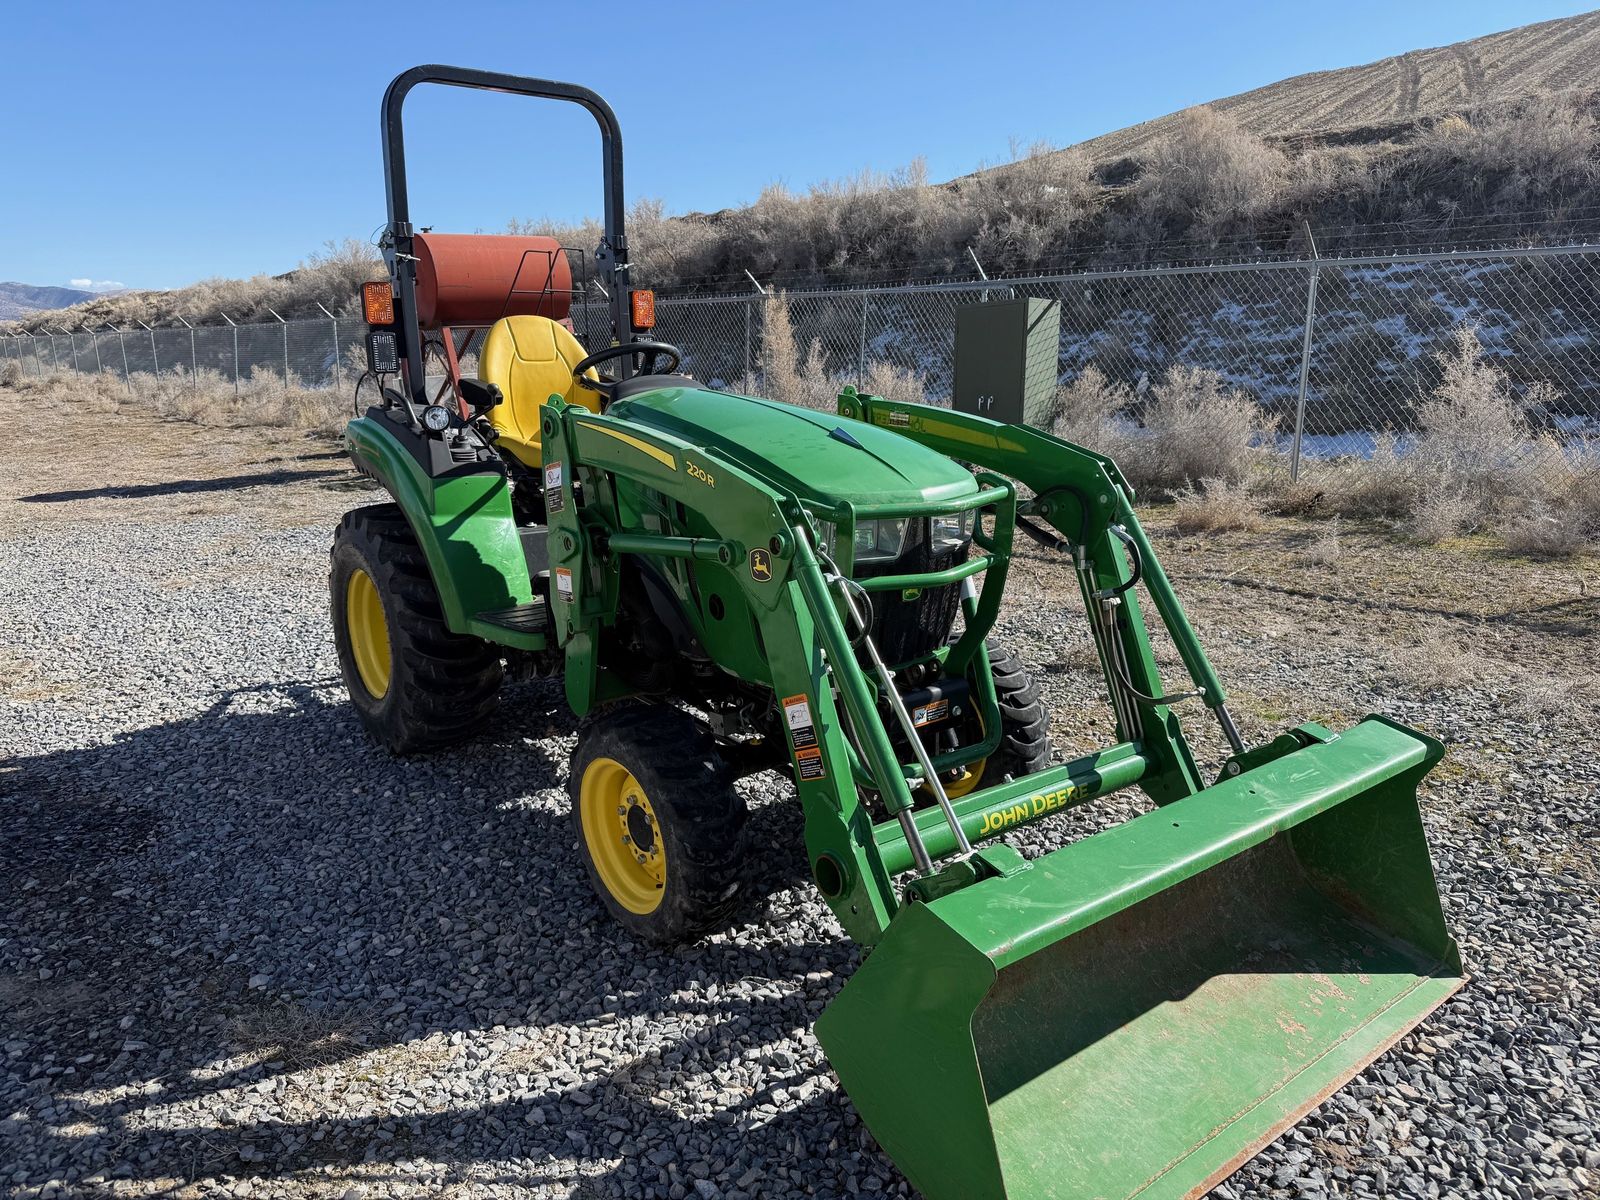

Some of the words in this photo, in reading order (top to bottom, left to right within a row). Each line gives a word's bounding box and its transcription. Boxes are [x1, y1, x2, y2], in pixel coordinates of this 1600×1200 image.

[686, 460, 715, 489] 220R
[980, 803, 1029, 834] JOHN
[1031, 783, 1089, 816] DEERE
